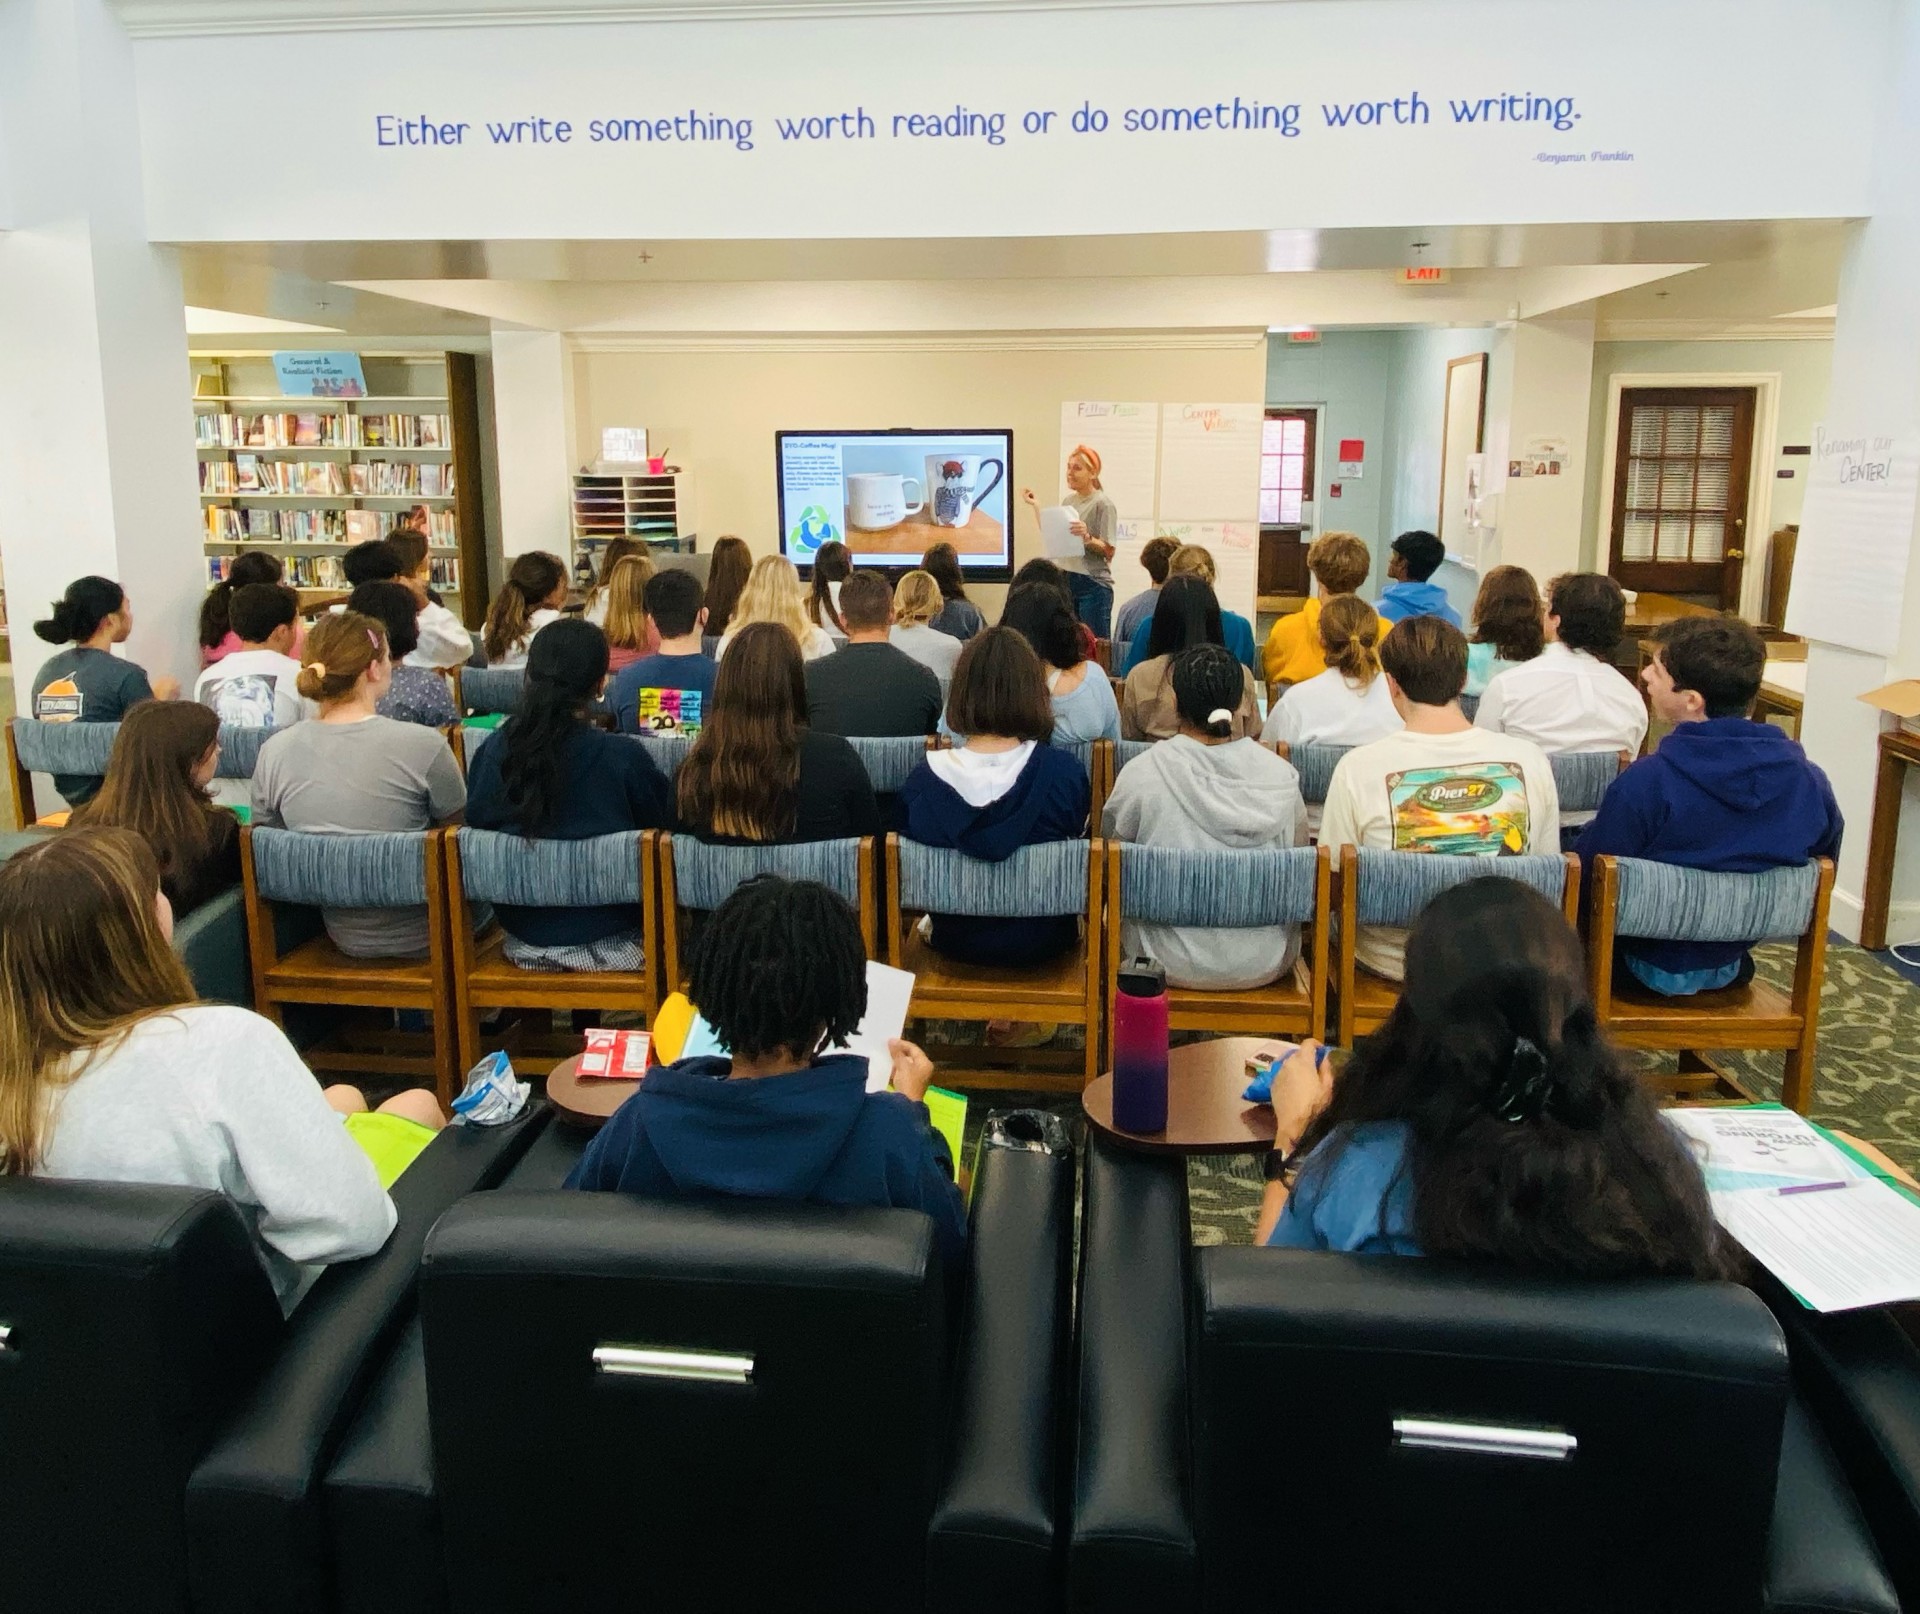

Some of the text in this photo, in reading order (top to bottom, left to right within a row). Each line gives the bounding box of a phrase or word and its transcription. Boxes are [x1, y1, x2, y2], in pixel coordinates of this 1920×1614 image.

[375, 90, 1582, 151] Either write something worth reading or do something worth writing.
[1590, 150, 1634, 162] Franklin
[289, 357, 331, 365] General &
[282, 367, 343, 375] Realistic Fiction
[652, 714, 676, 730] 20
